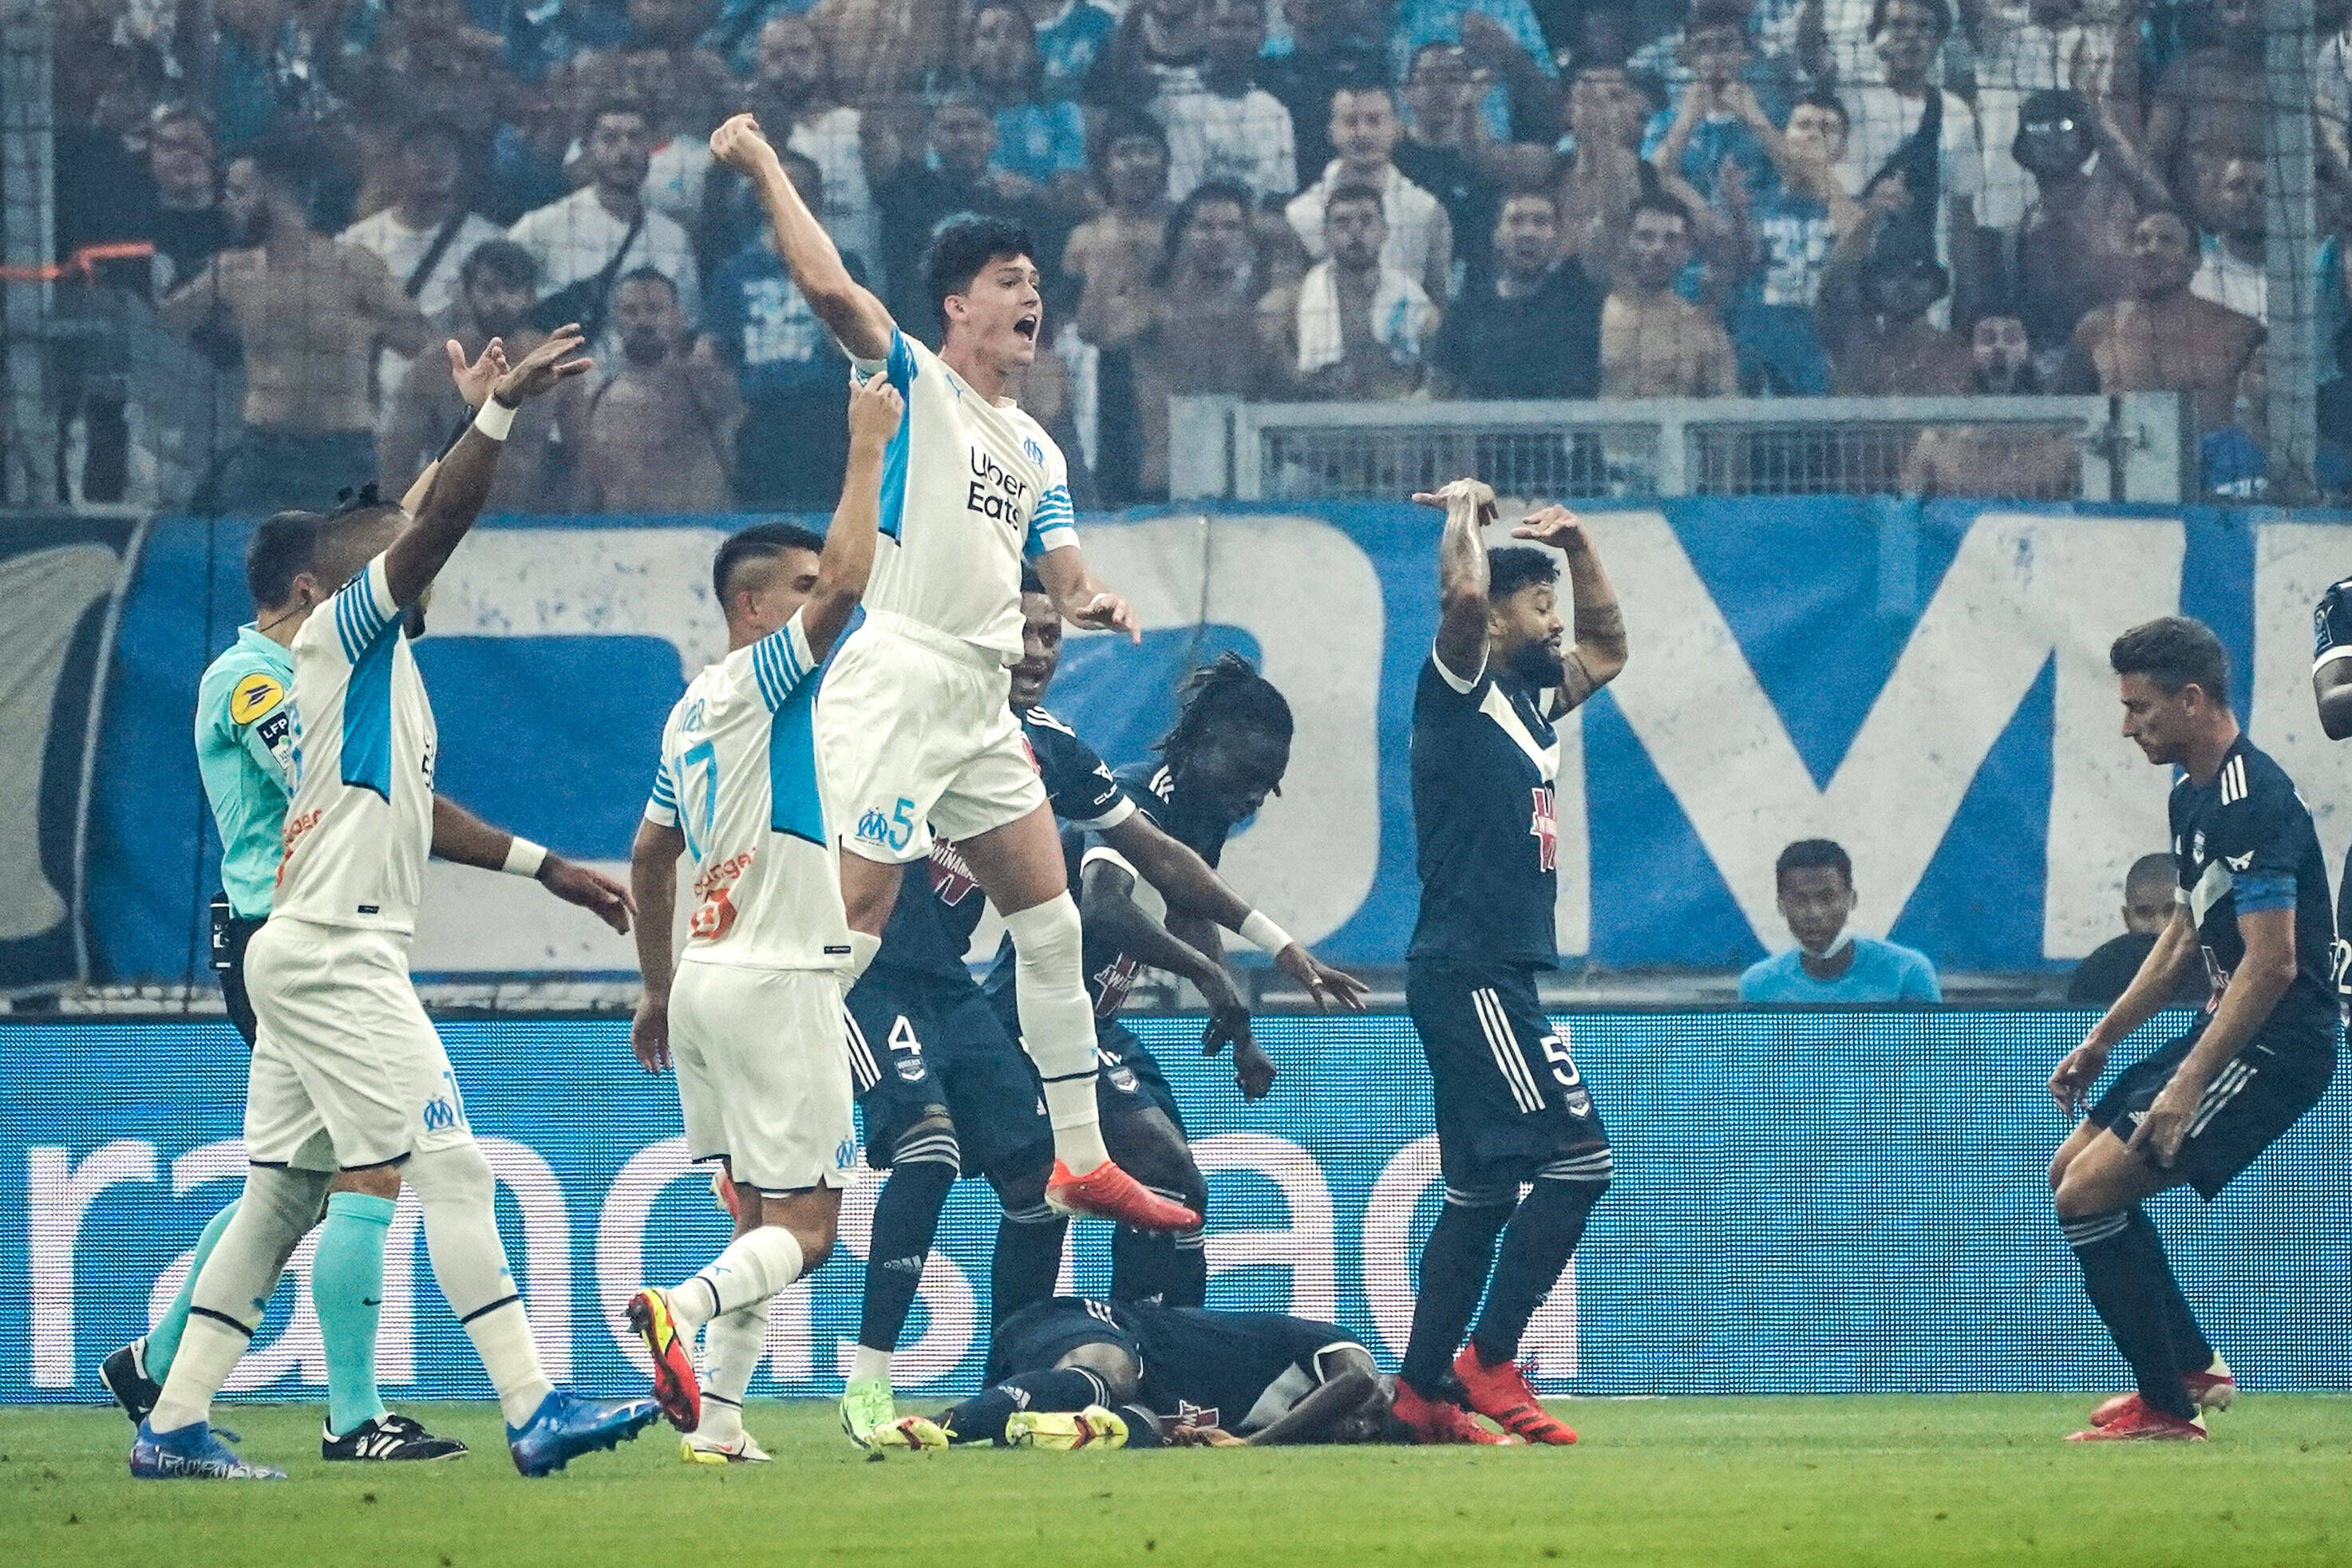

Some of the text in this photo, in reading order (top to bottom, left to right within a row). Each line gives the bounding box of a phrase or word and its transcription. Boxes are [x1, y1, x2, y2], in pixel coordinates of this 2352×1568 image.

[970, 445, 1027, 500] Uber
[263, 718, 288, 740] LFP
[675, 739, 717, 863] 17
[888, 796, 915, 851] 5
[887, 1014, 922, 1056] 4
[1540, 1036, 1581, 1086] 5
